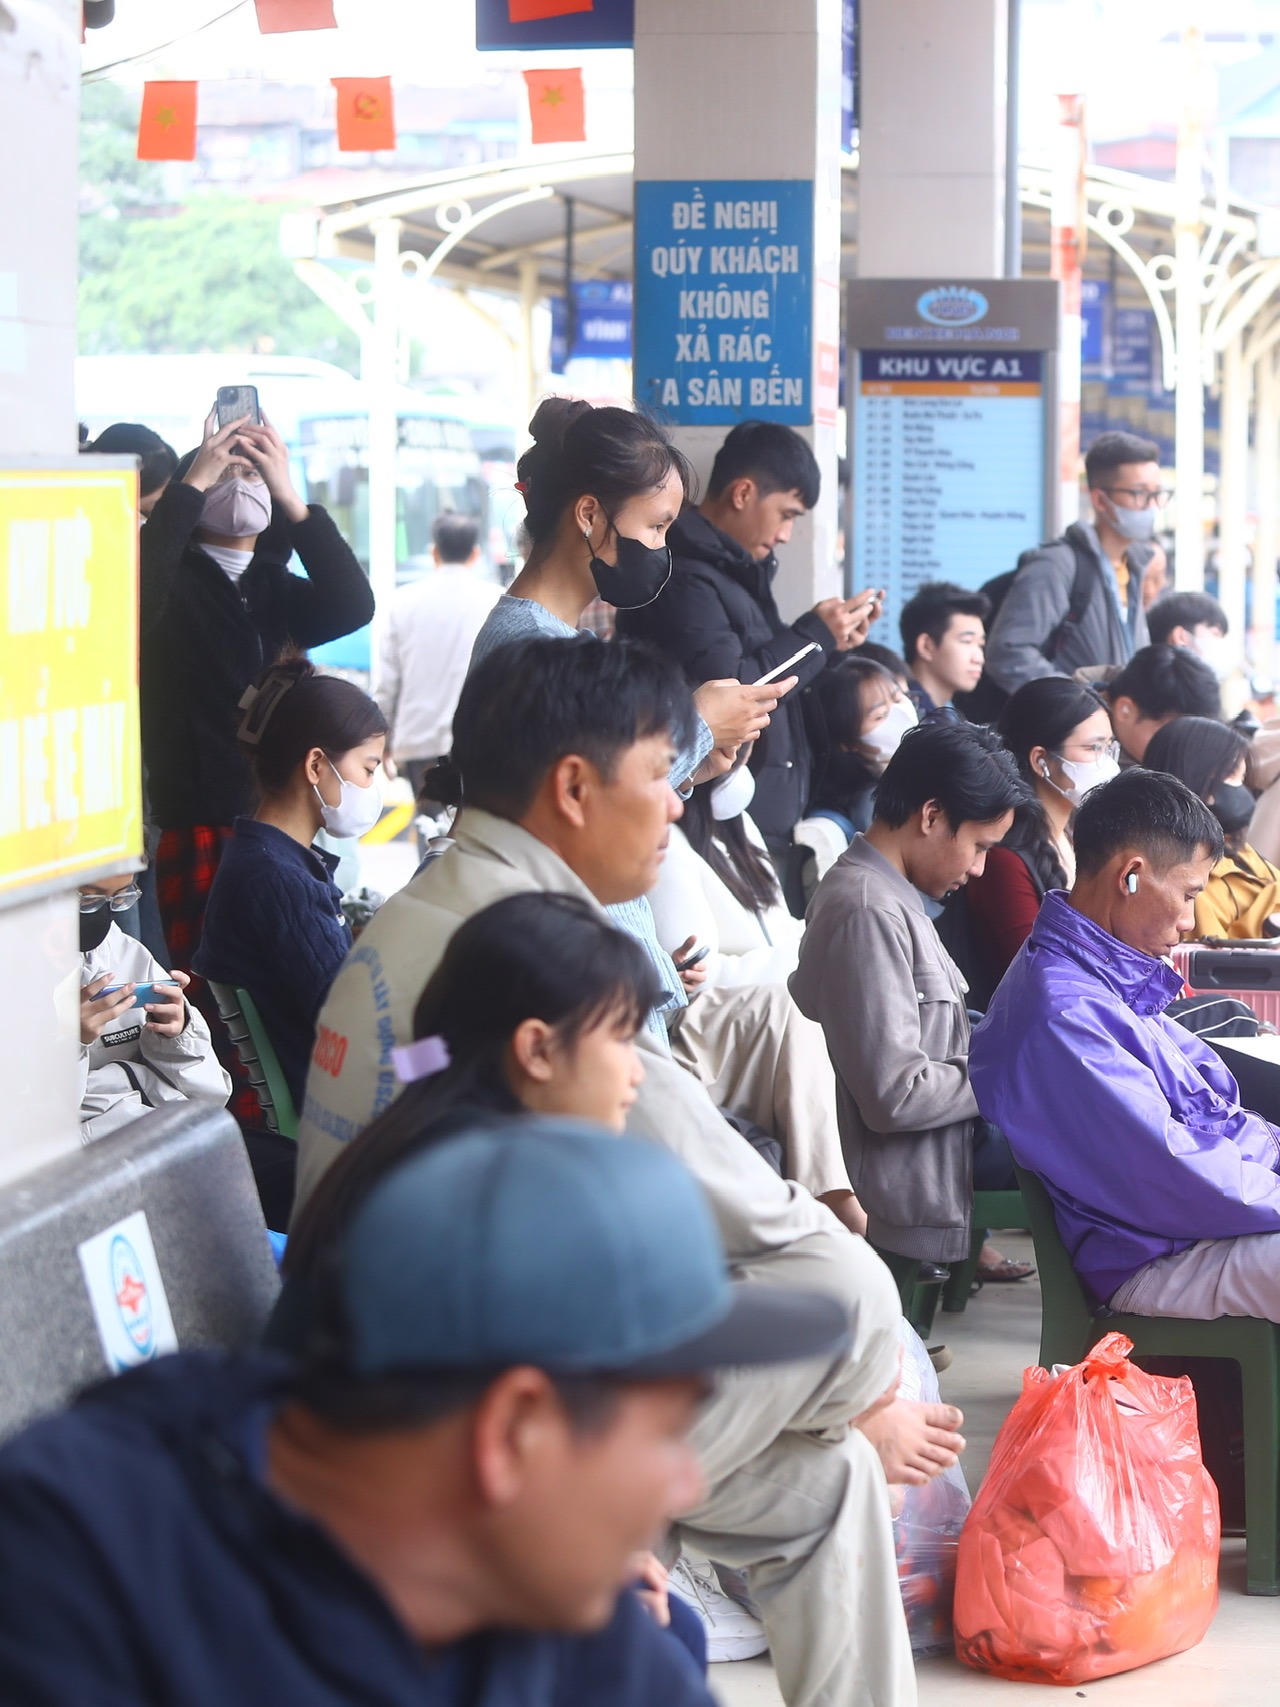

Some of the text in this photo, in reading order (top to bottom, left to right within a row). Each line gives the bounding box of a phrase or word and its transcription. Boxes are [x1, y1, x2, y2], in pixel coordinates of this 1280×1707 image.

[672, 187, 778, 235] ĐỀ NGHỊ
[709, 236, 799, 275] KHÁCH
[679, 282, 770, 319] KHÔNG
[675, 323, 773, 363] XẢ RÁC
[687, 369, 742, 407] SÂN
[750, 363, 804, 407] BẾN
[878, 354, 1023, 380] KHU VỰC A1
